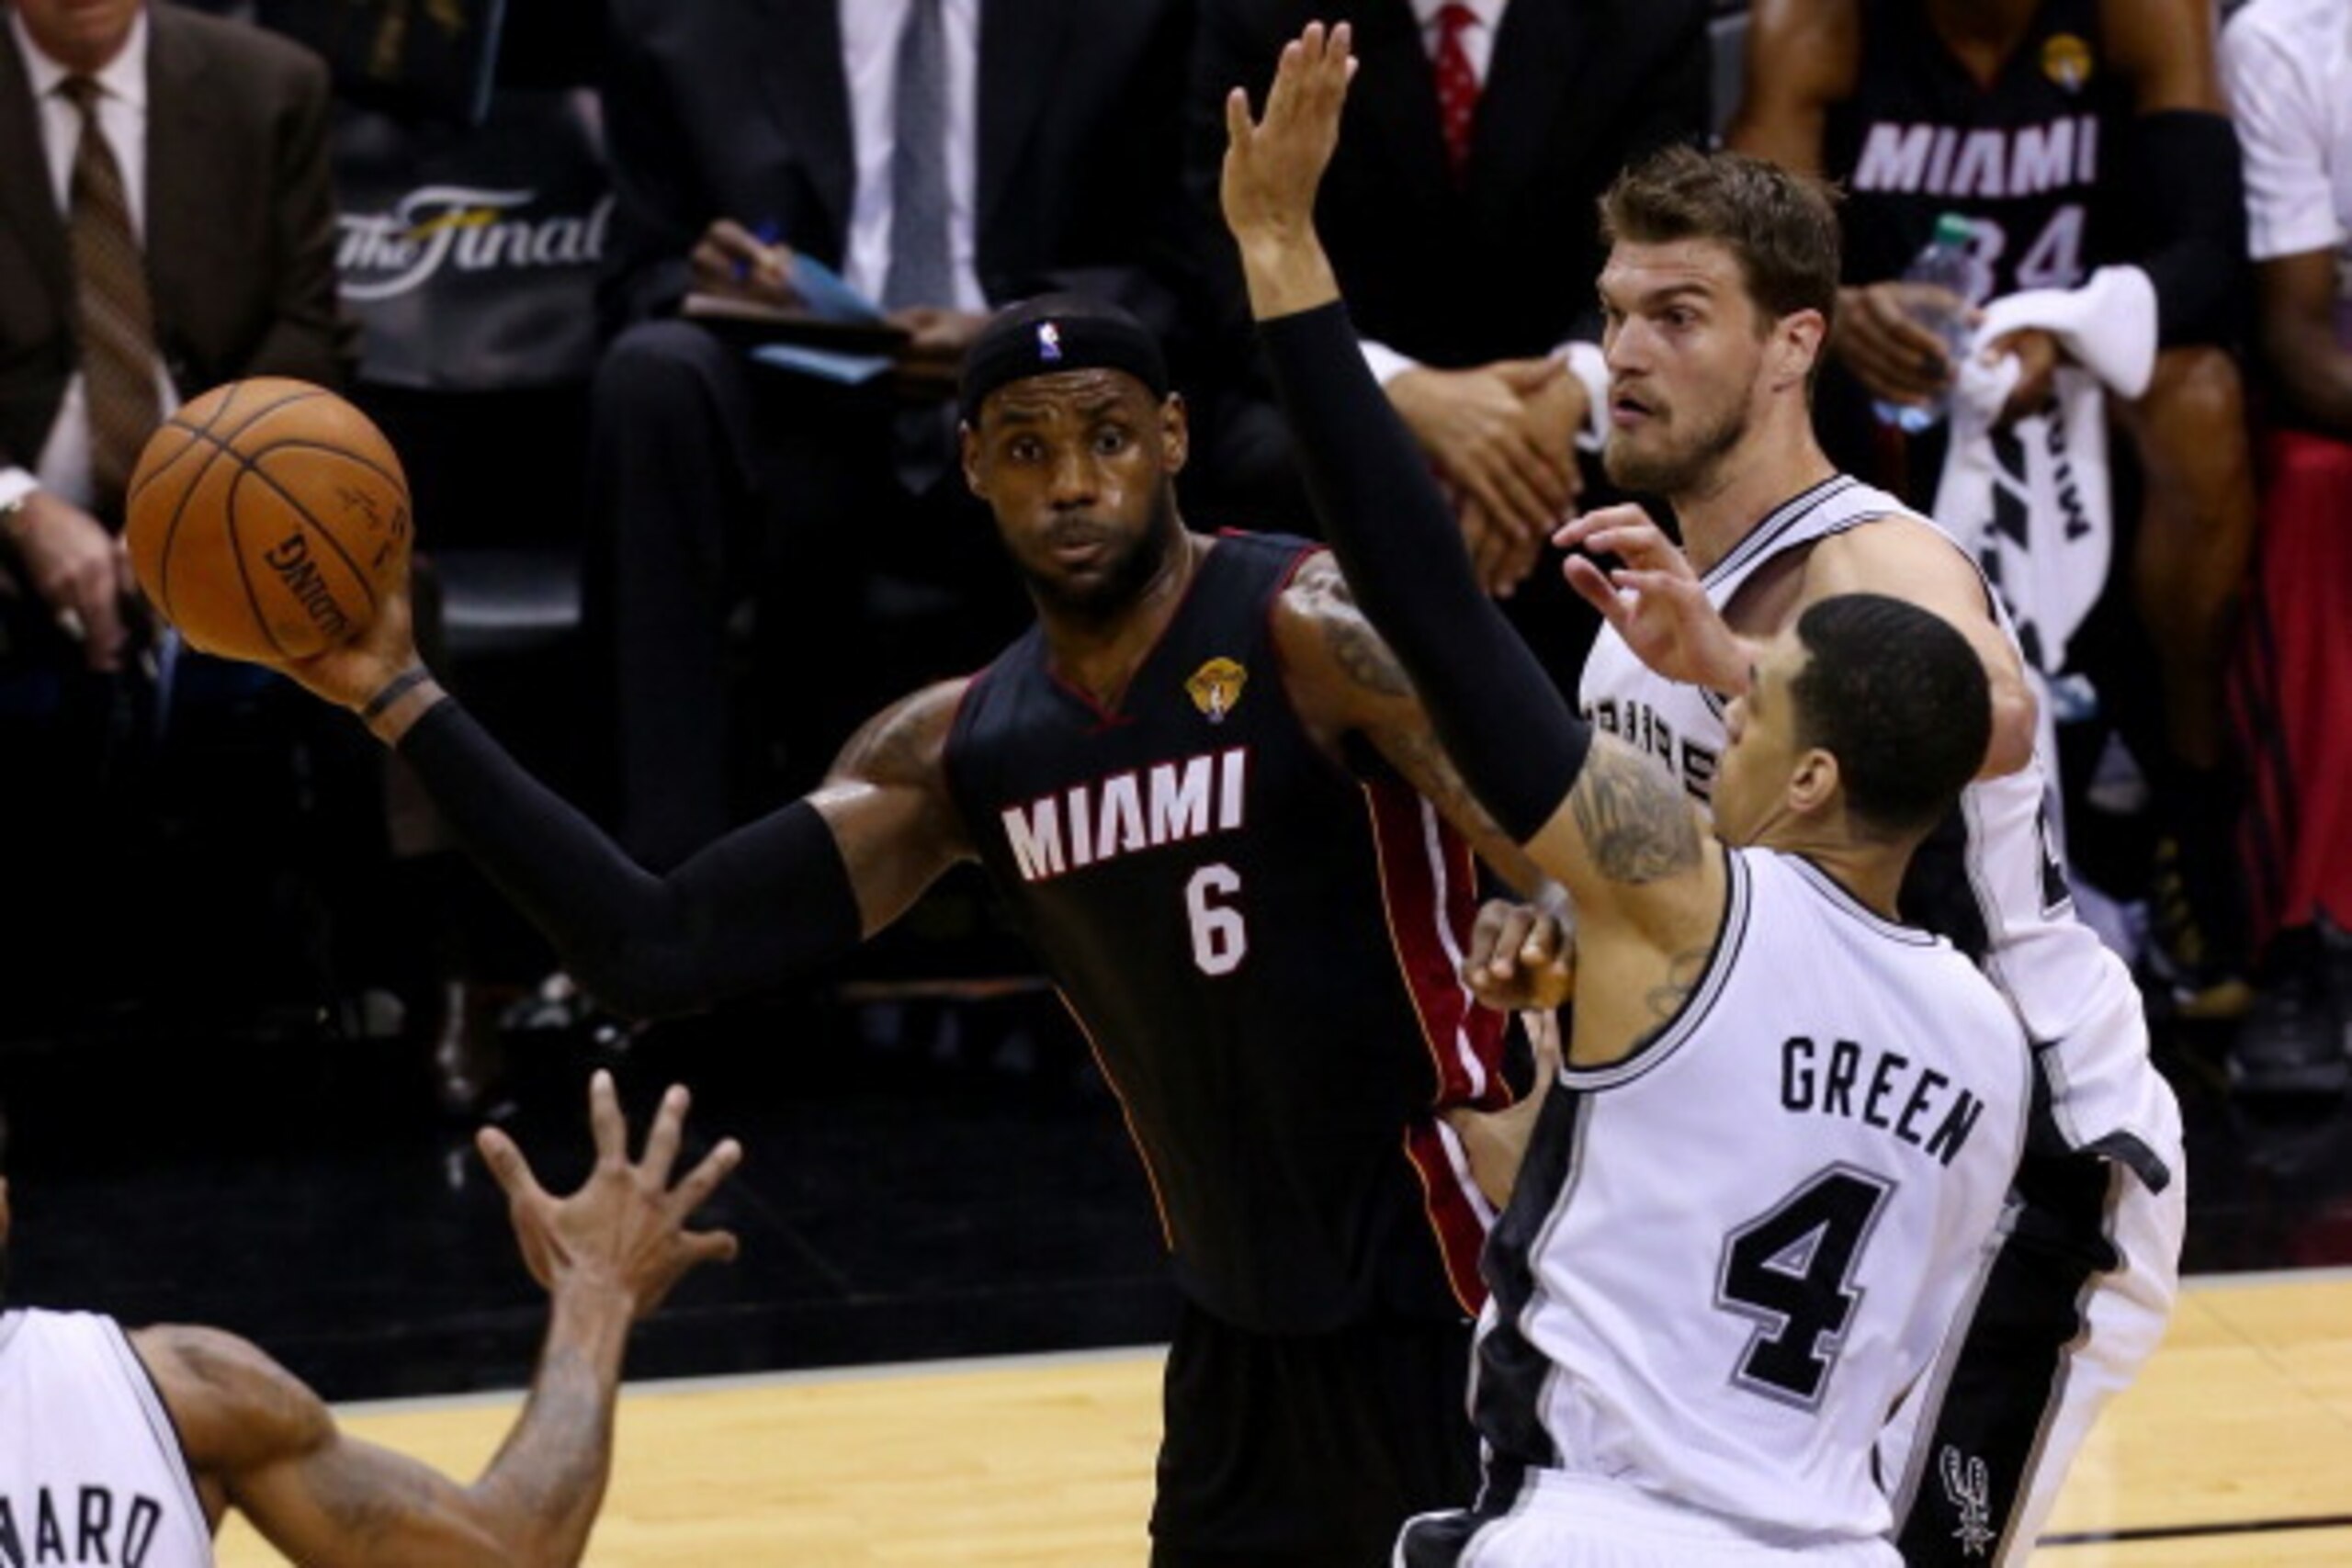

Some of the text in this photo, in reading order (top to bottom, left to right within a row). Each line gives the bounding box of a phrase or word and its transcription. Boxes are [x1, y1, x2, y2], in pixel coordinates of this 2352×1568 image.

[1854, 113, 2098, 197] MIAMI
[335, 213, 420, 269] The
[1000, 746, 1247, 883] MIAMI
[1183, 861, 1249, 977] 6
[1781, 1035, 1985, 1167] GREEN
[1712, 1159, 1901, 1415] 4
